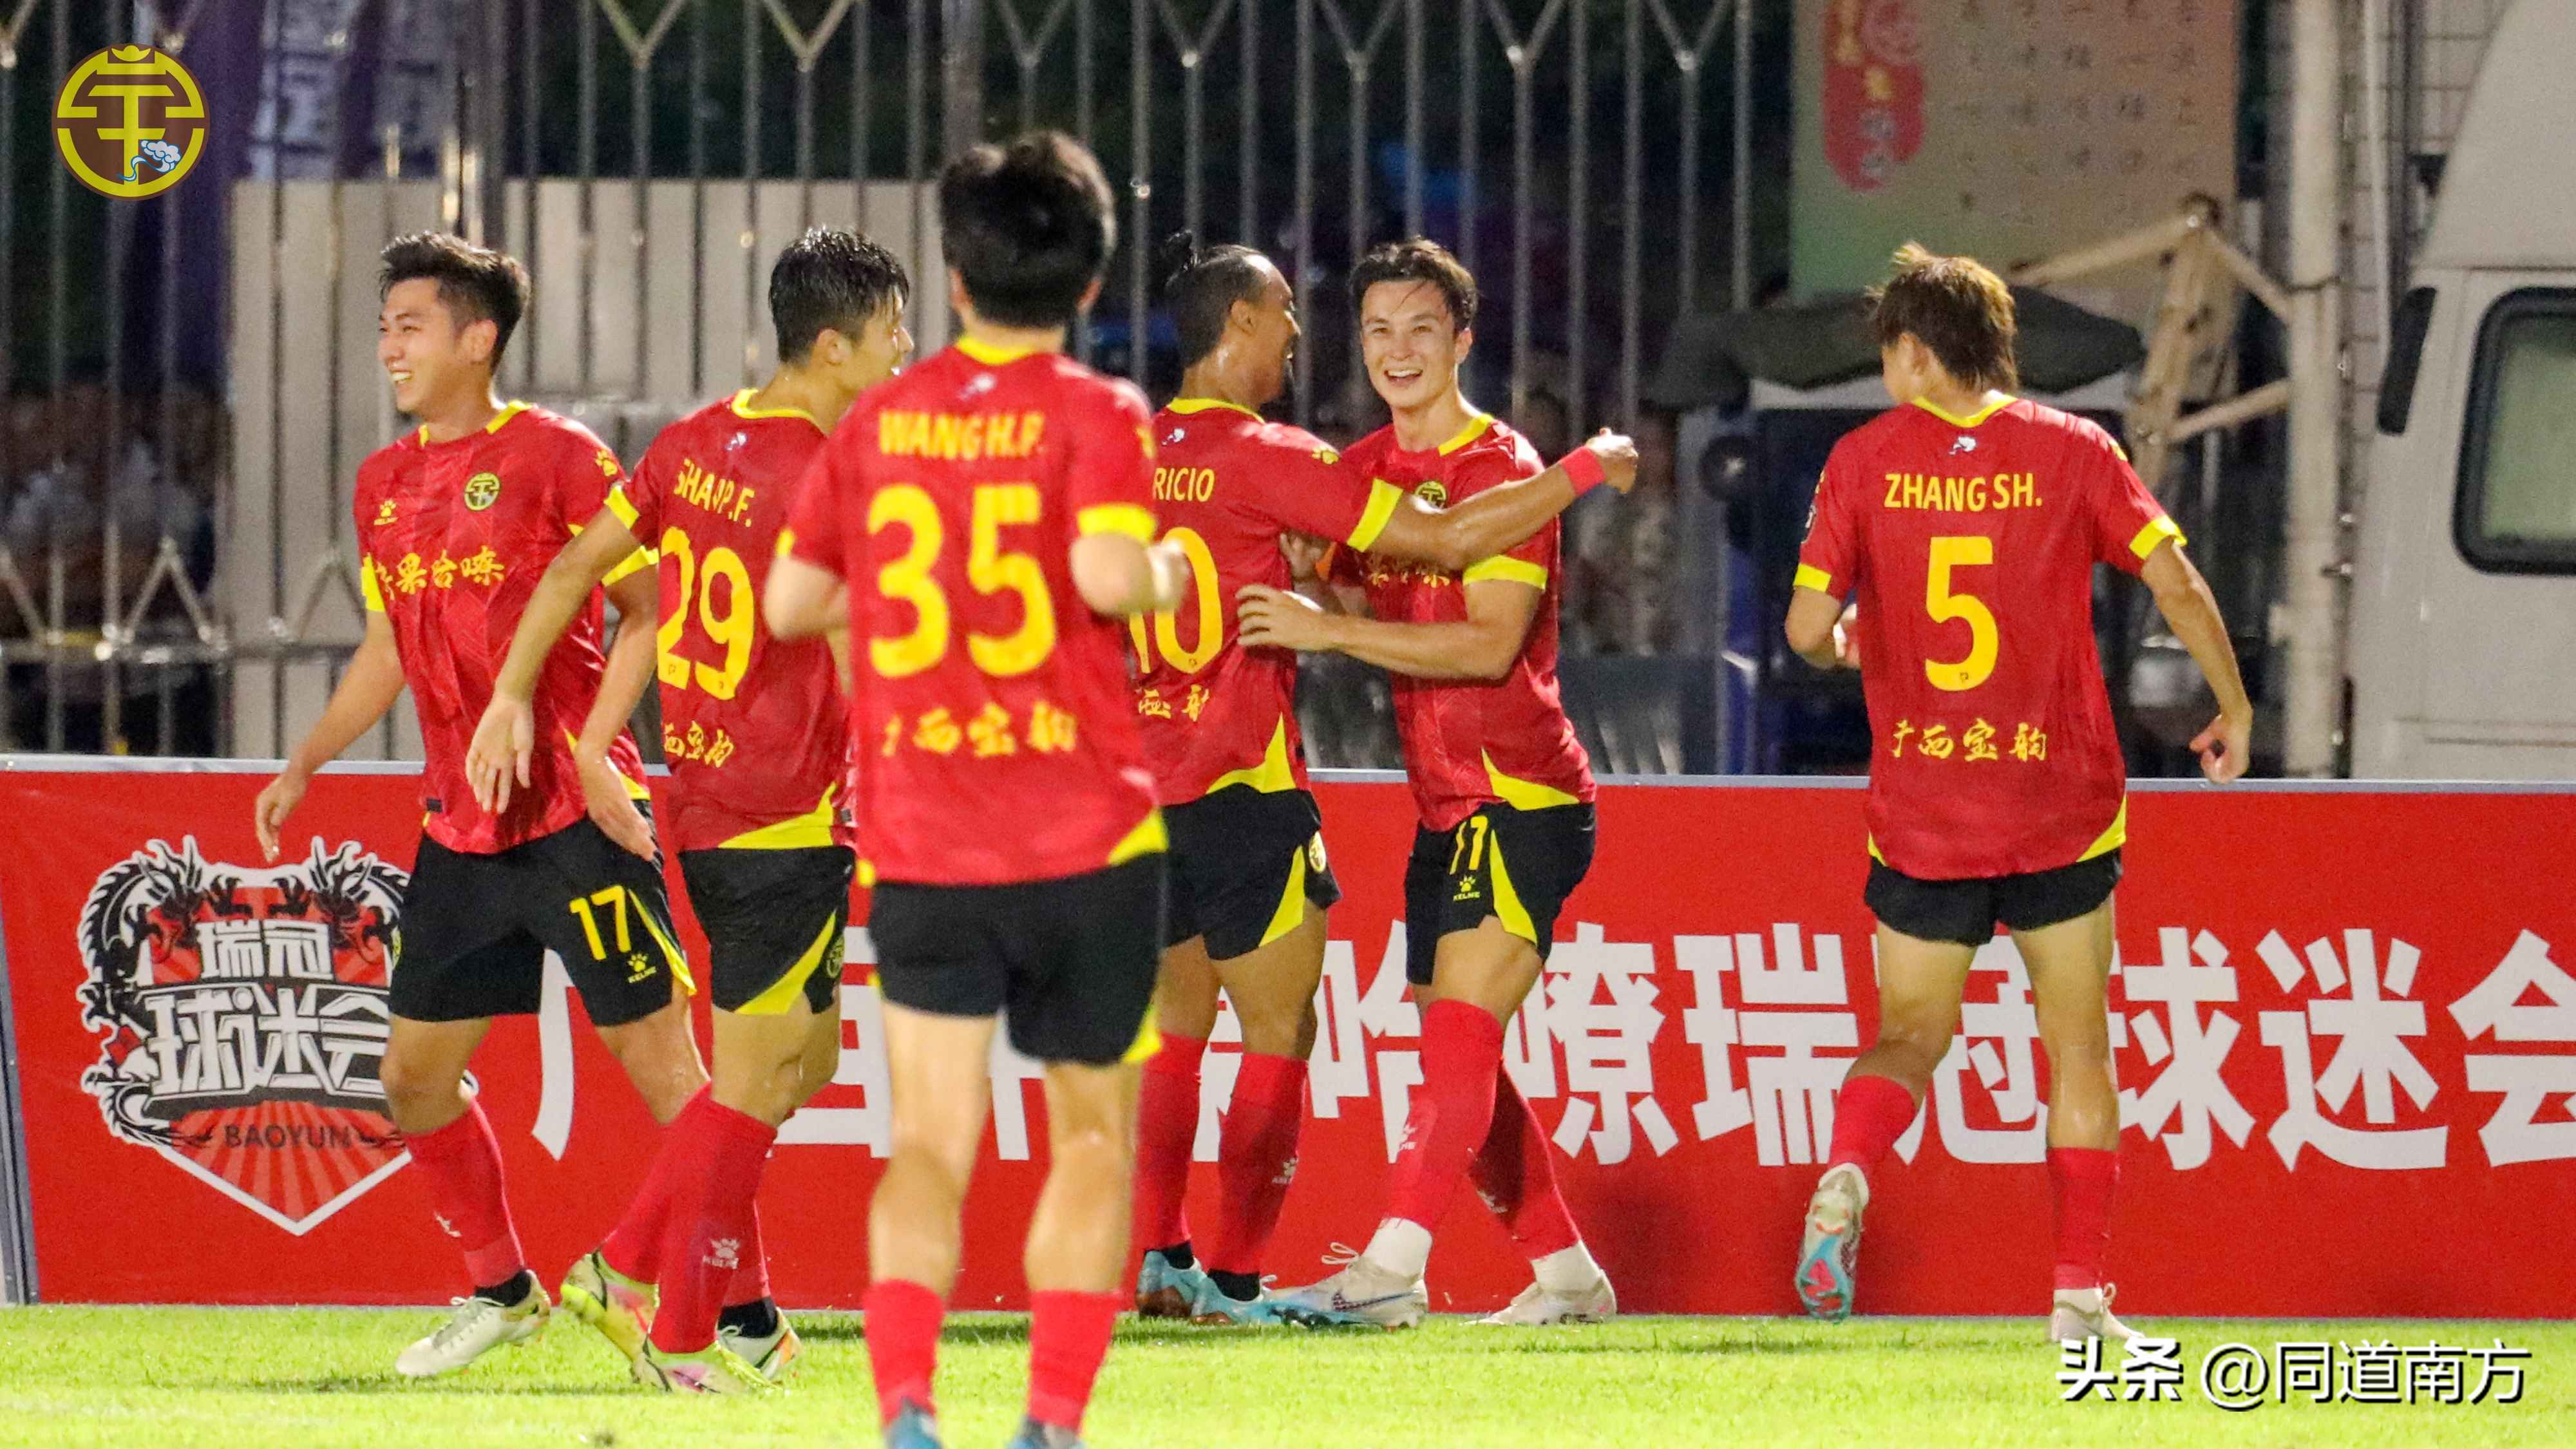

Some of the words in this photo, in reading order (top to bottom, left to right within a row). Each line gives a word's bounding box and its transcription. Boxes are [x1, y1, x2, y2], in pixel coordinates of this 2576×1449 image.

[1152, 468, 1215, 502] RICIO
[1884, 473, 1986, 512] ZHANG
[1993, 473, 2043, 509] SH.
[657, 526, 755, 700] 29
[867, 483, 1057, 677] 35
[1924, 536, 1999, 692] 5
[196, 919, 336, 980] 瑞冠
[569, 885, 632, 961] 17
[146, 983, 390, 1094] 球迷会
[225, 1124, 352, 1150] BAOYUN
